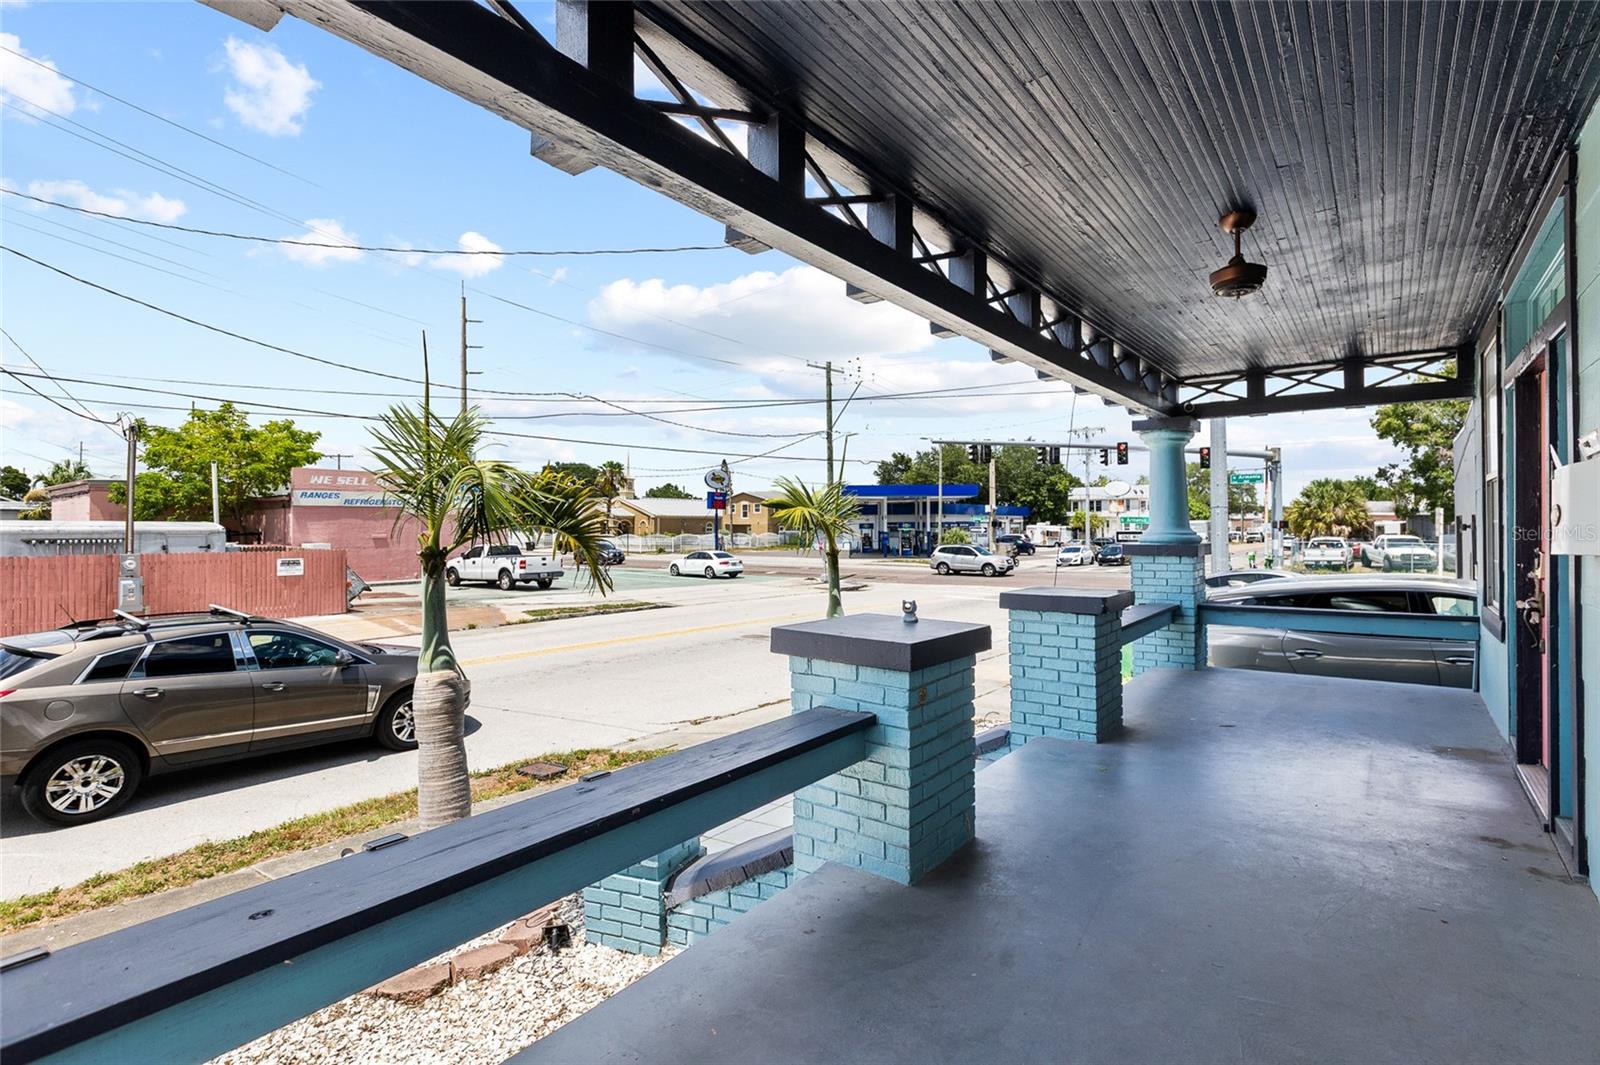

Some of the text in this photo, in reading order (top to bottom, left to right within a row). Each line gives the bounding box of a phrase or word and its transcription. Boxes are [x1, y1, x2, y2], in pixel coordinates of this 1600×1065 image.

[309, 475, 333, 485] WE
[336, 476, 369, 486] SELL
[300, 491, 341, 499] RANGES
[343, 498, 403, 506] REFRIGERATO
